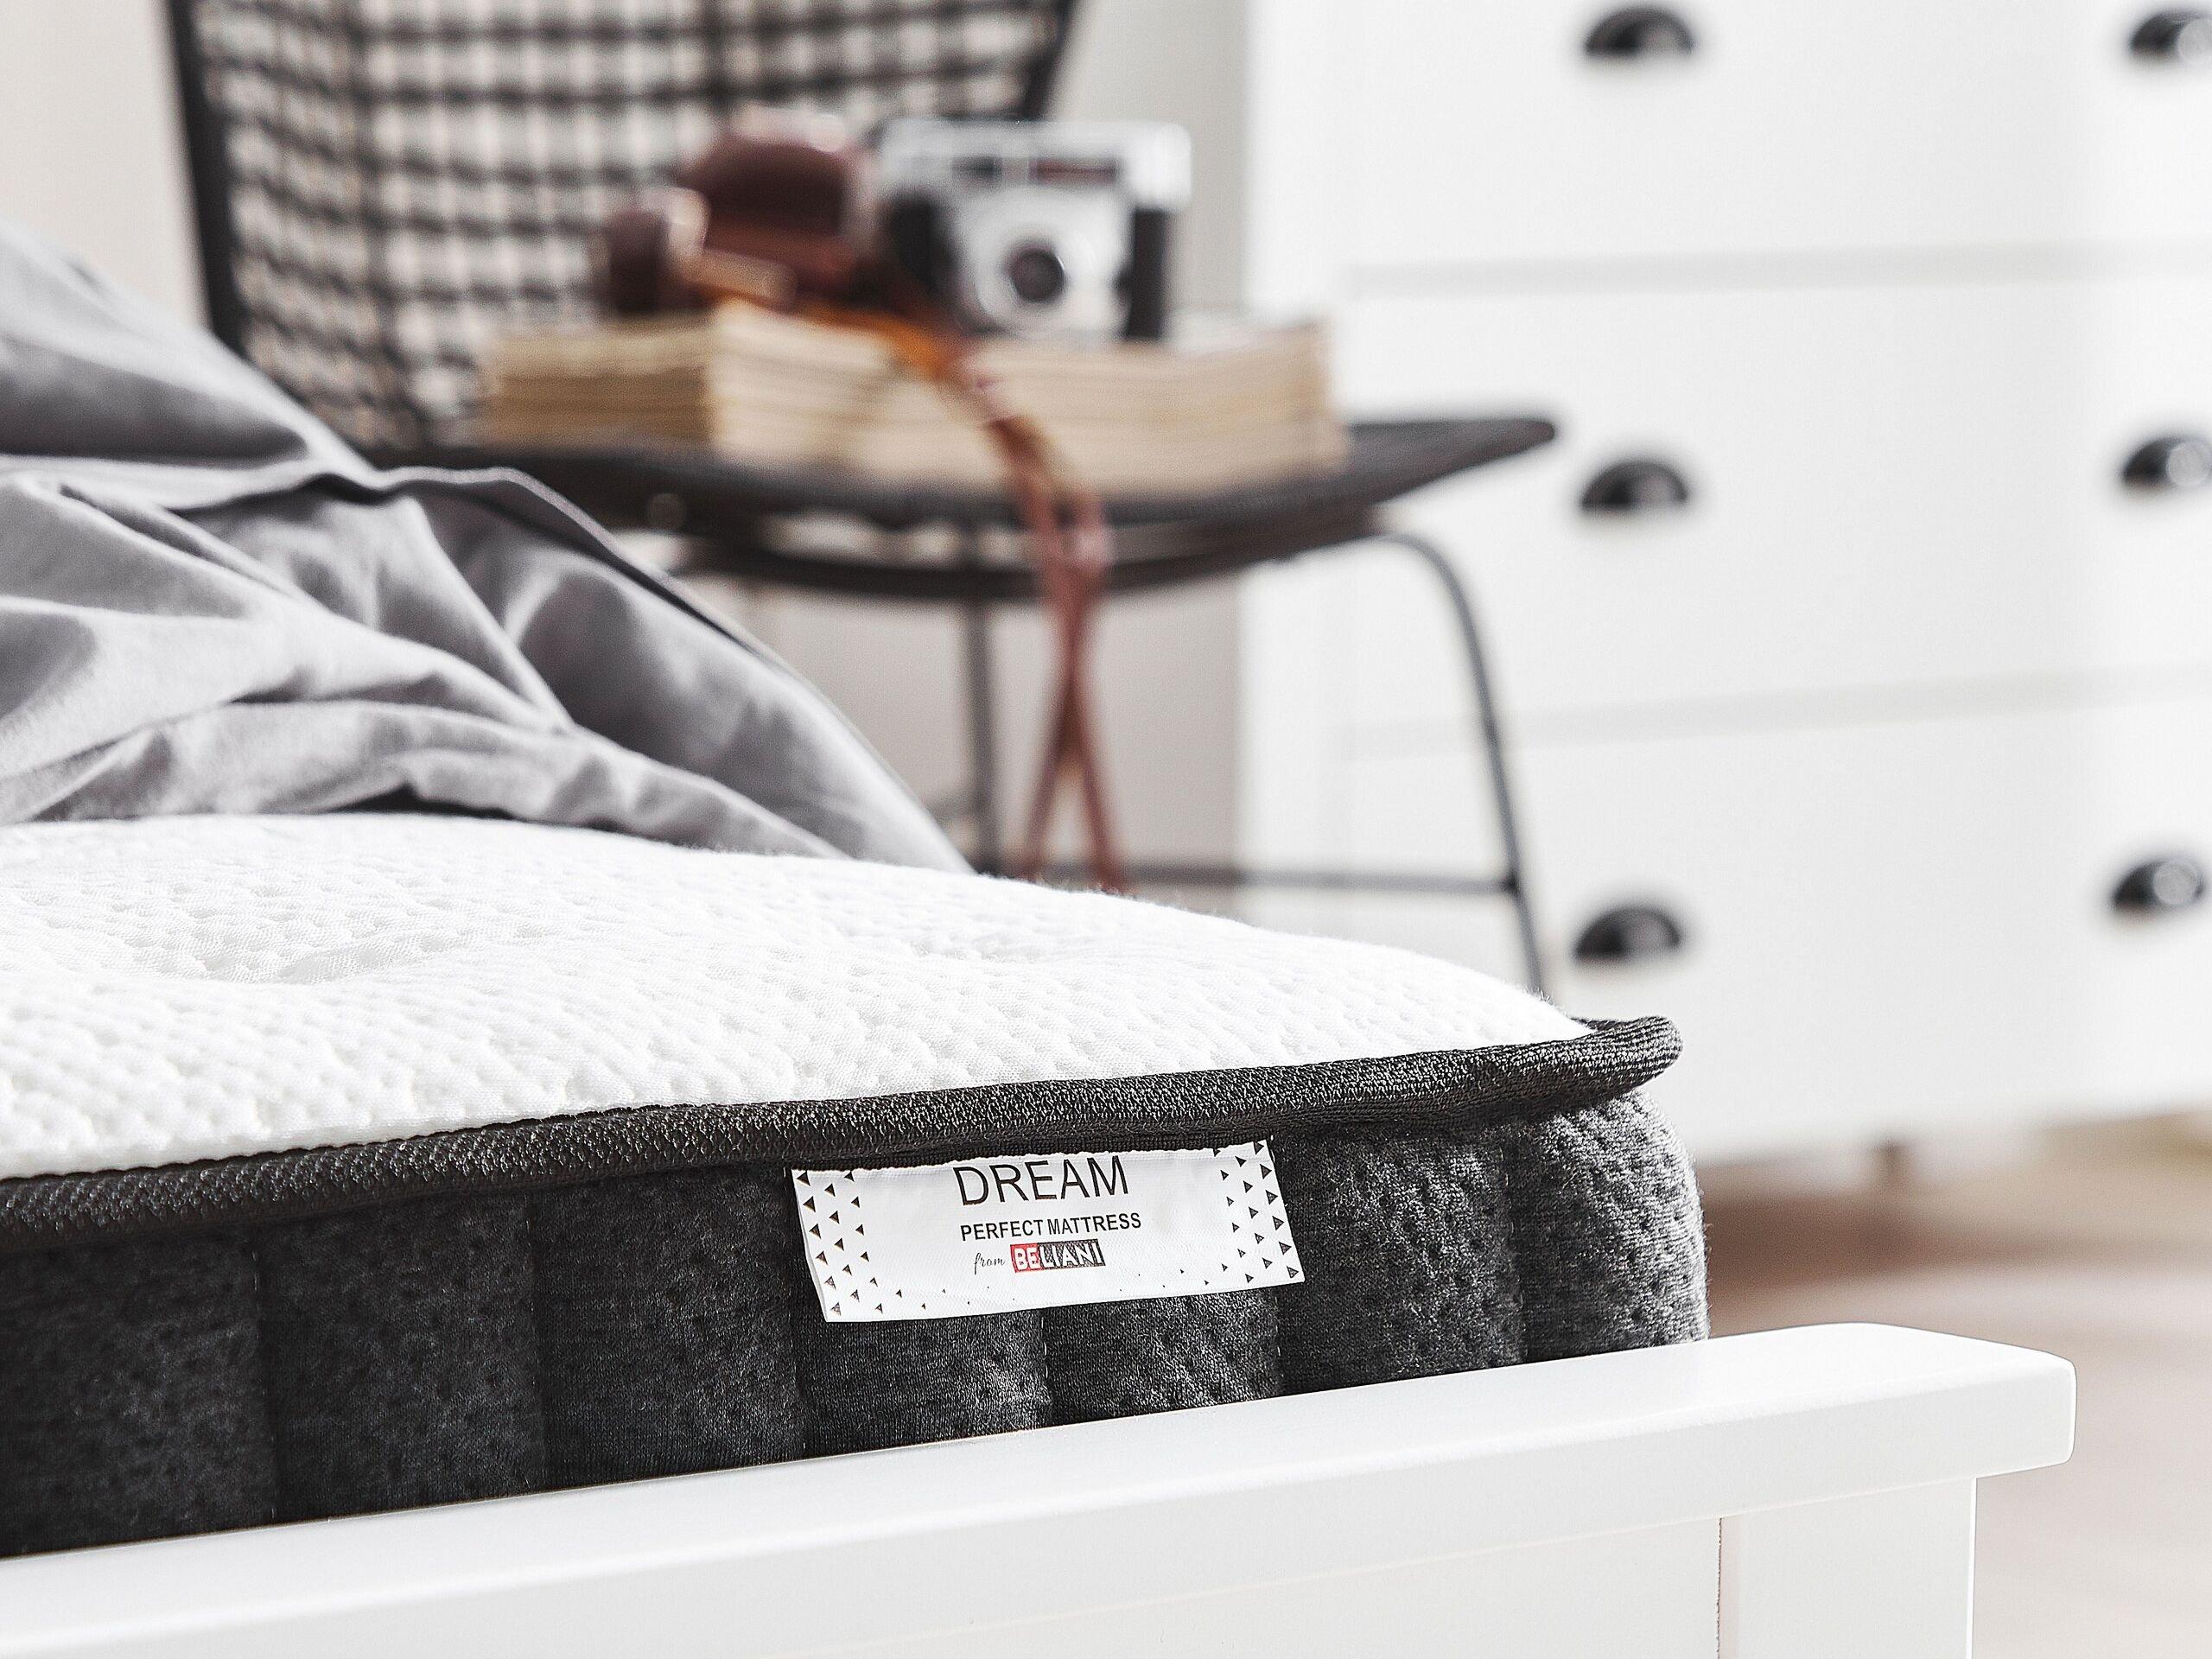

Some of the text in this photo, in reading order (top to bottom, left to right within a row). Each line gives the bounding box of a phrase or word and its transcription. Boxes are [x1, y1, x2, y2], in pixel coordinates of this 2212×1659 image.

[952, 1155, 1128, 1206] DREAM
[960, 1212, 1141, 1242] PERFECT MATTRESS
[974, 1242, 1103, 1275] from BELIANI
